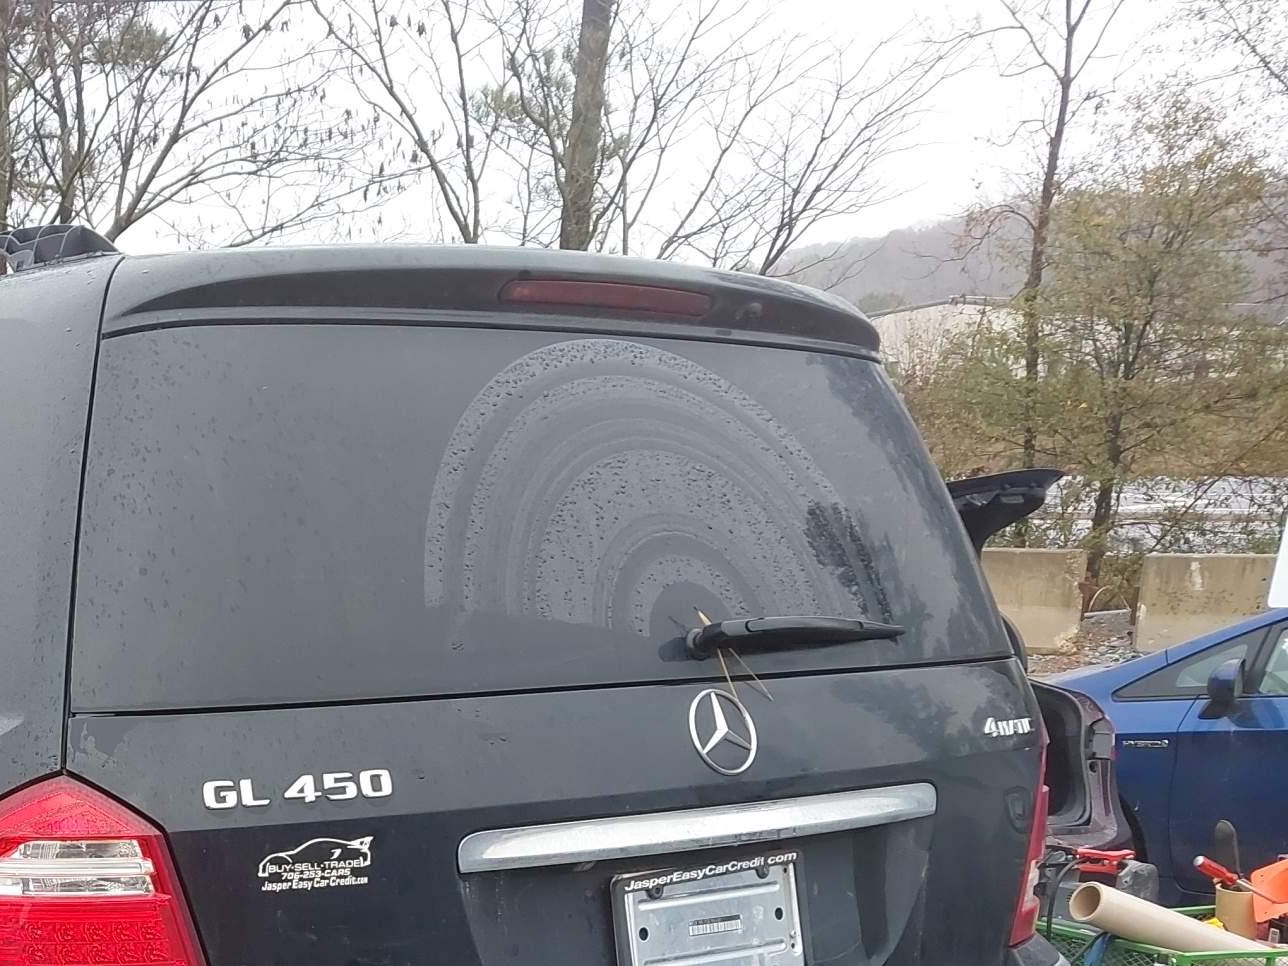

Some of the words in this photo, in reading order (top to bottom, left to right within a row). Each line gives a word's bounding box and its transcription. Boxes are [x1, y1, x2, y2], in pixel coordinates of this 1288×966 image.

[202, 777, 270, 809] GL
[284, 768, 393, 803] 450
[624, 851, 797, 891] JasperEasyCarCreditcom
